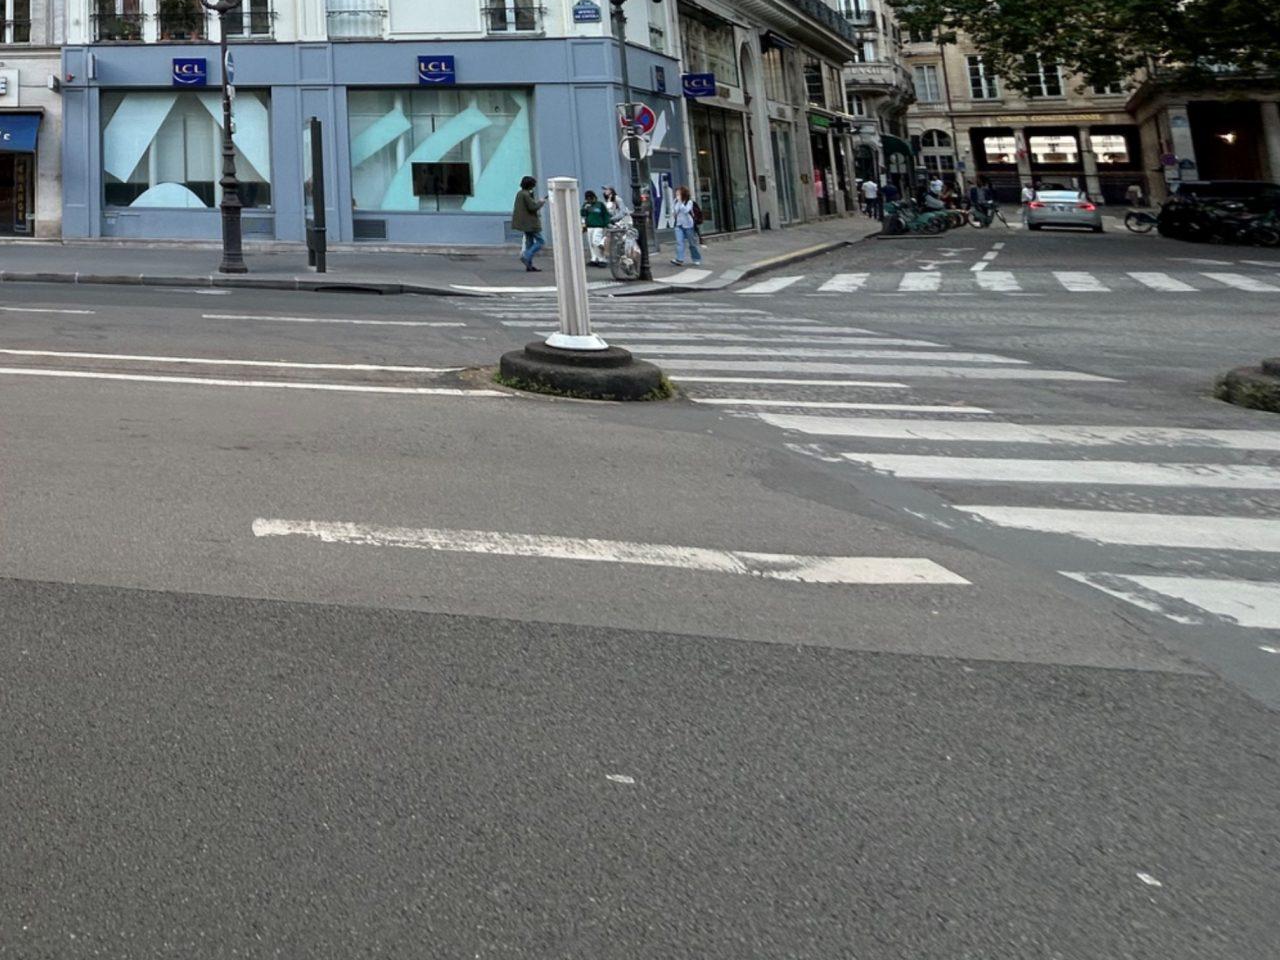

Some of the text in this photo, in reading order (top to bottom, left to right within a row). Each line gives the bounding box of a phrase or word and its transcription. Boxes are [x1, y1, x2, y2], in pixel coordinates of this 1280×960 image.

[175, 64, 203, 74] LCL
[420, 61, 451, 71] LCL
[684, 79, 710, 88] LCL
